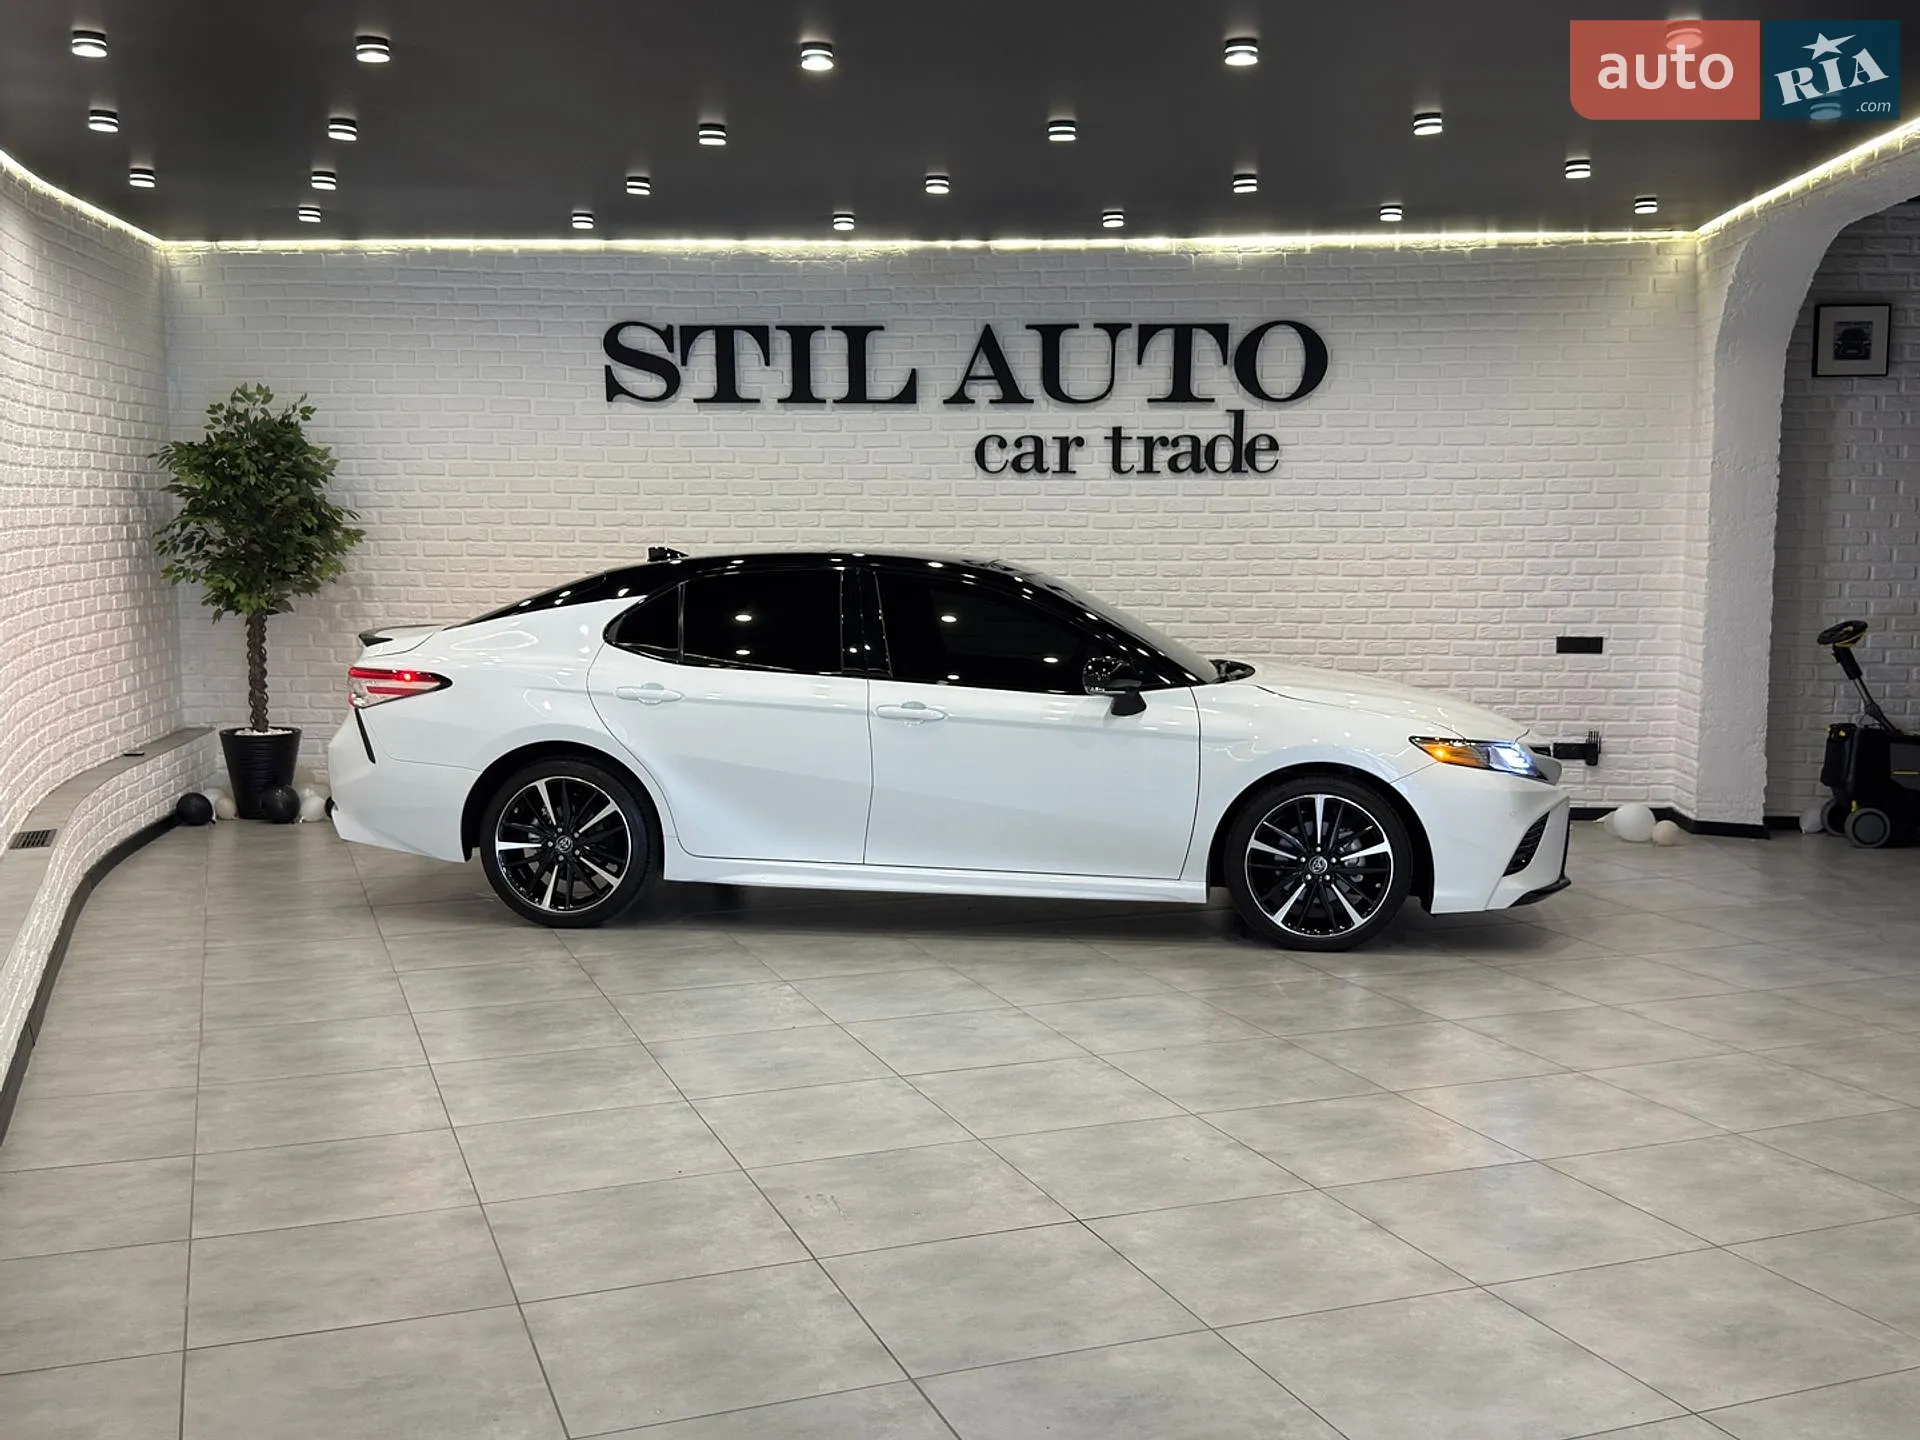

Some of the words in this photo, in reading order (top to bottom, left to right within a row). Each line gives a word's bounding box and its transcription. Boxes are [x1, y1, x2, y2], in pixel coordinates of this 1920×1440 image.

[603, 320, 918, 405] STIL
[943, 319, 1330, 405] AUTO
[974, 433, 1085, 475] car
[1103, 408, 1280, 475] trade
